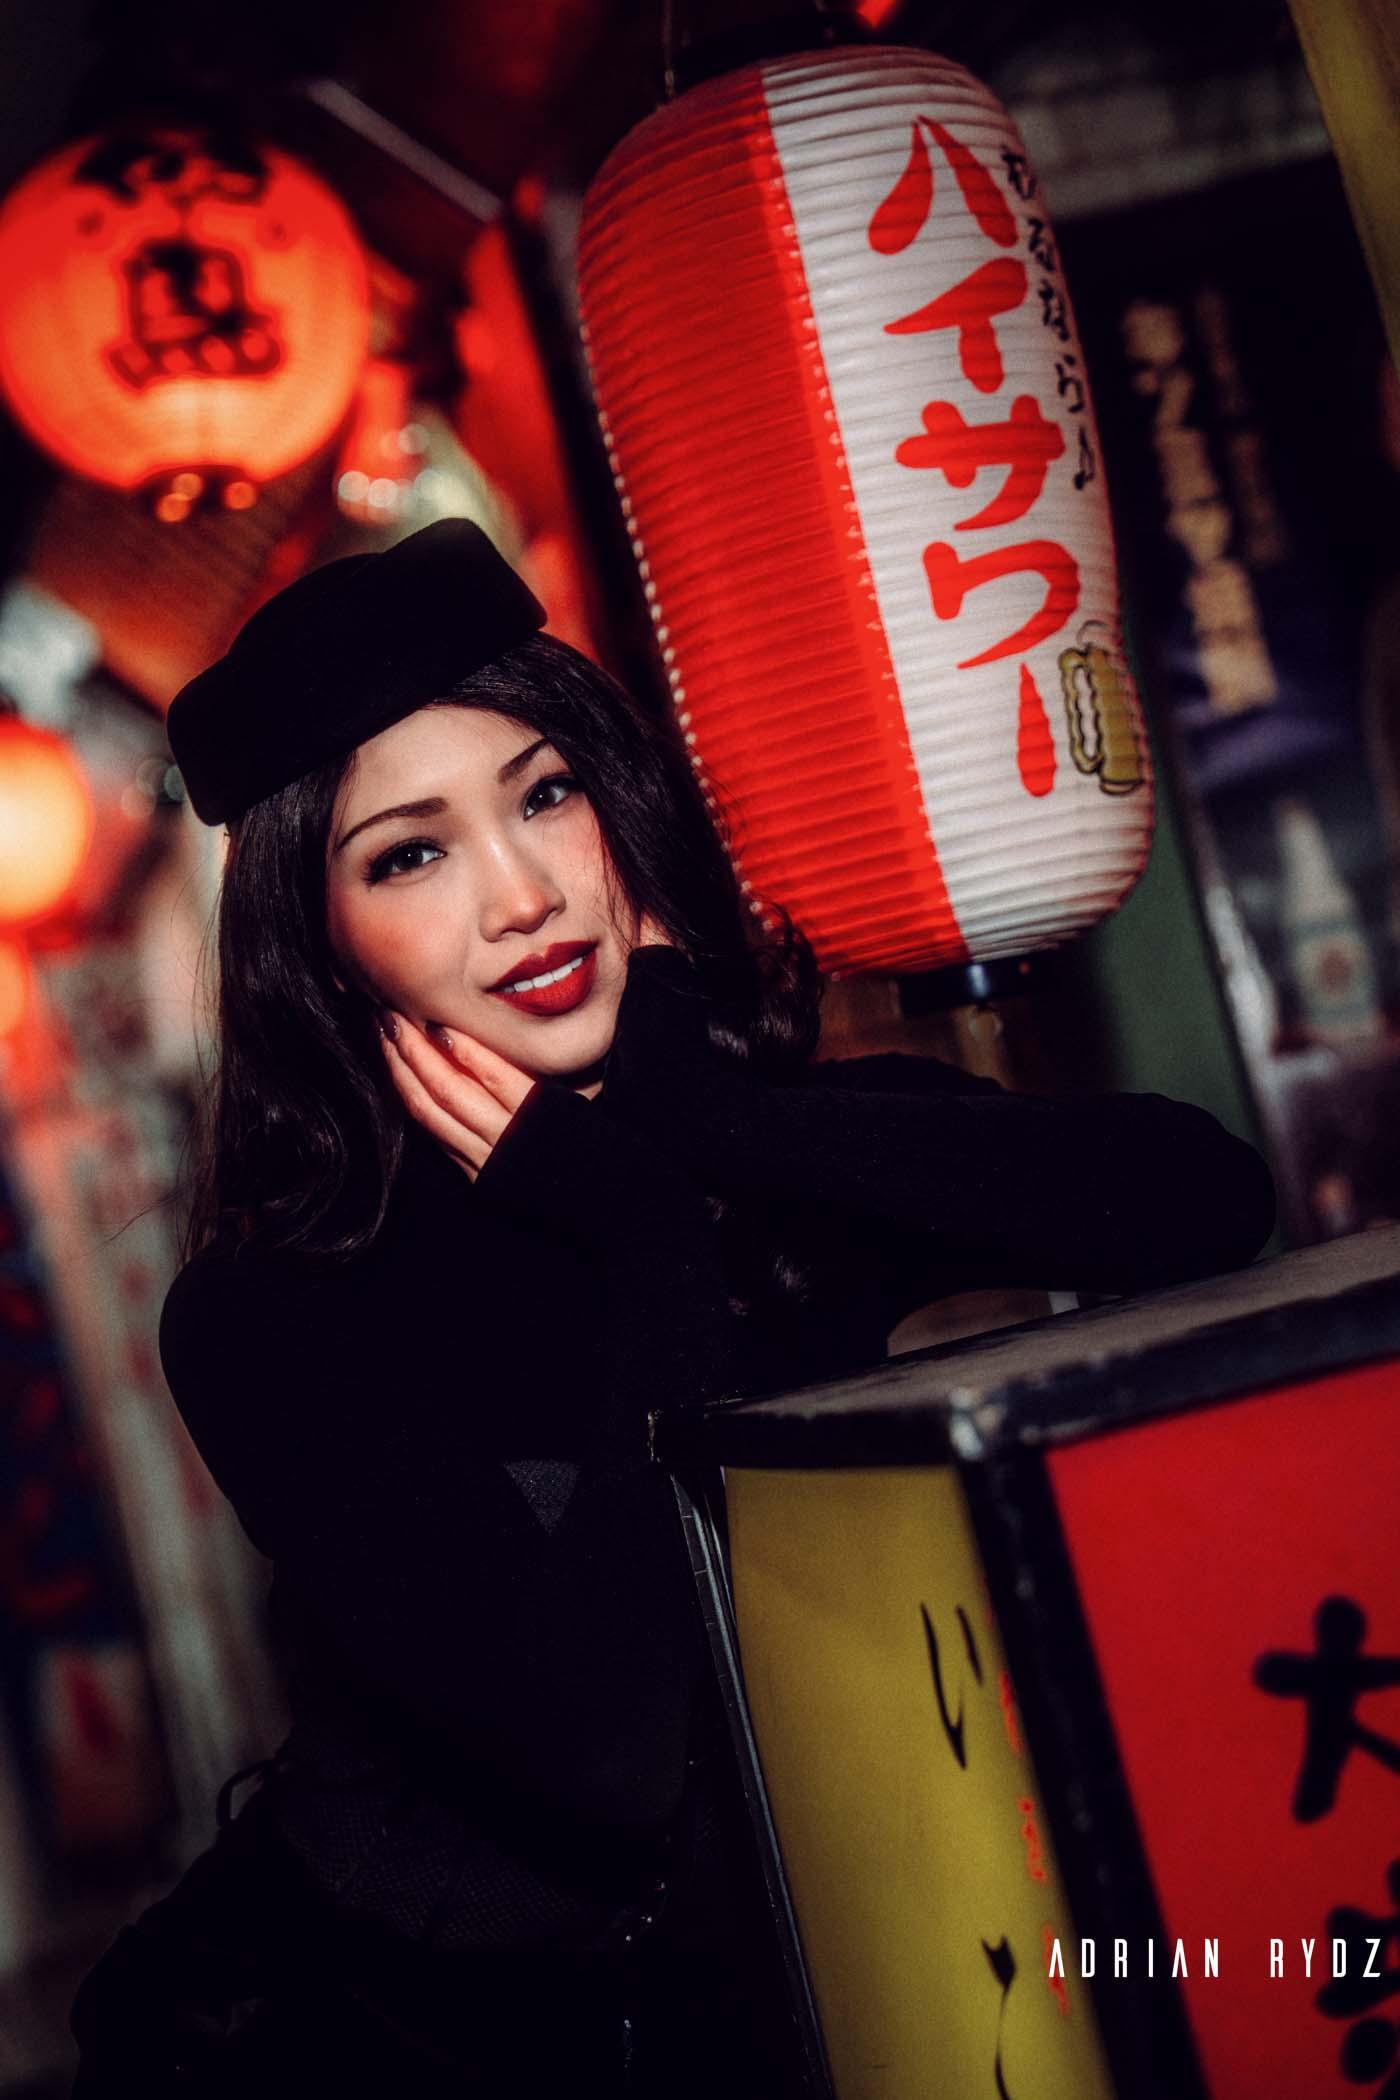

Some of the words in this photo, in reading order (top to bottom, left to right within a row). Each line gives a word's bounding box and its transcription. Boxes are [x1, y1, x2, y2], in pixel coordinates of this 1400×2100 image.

[867, 114, 1081, 798] ハイサワー
